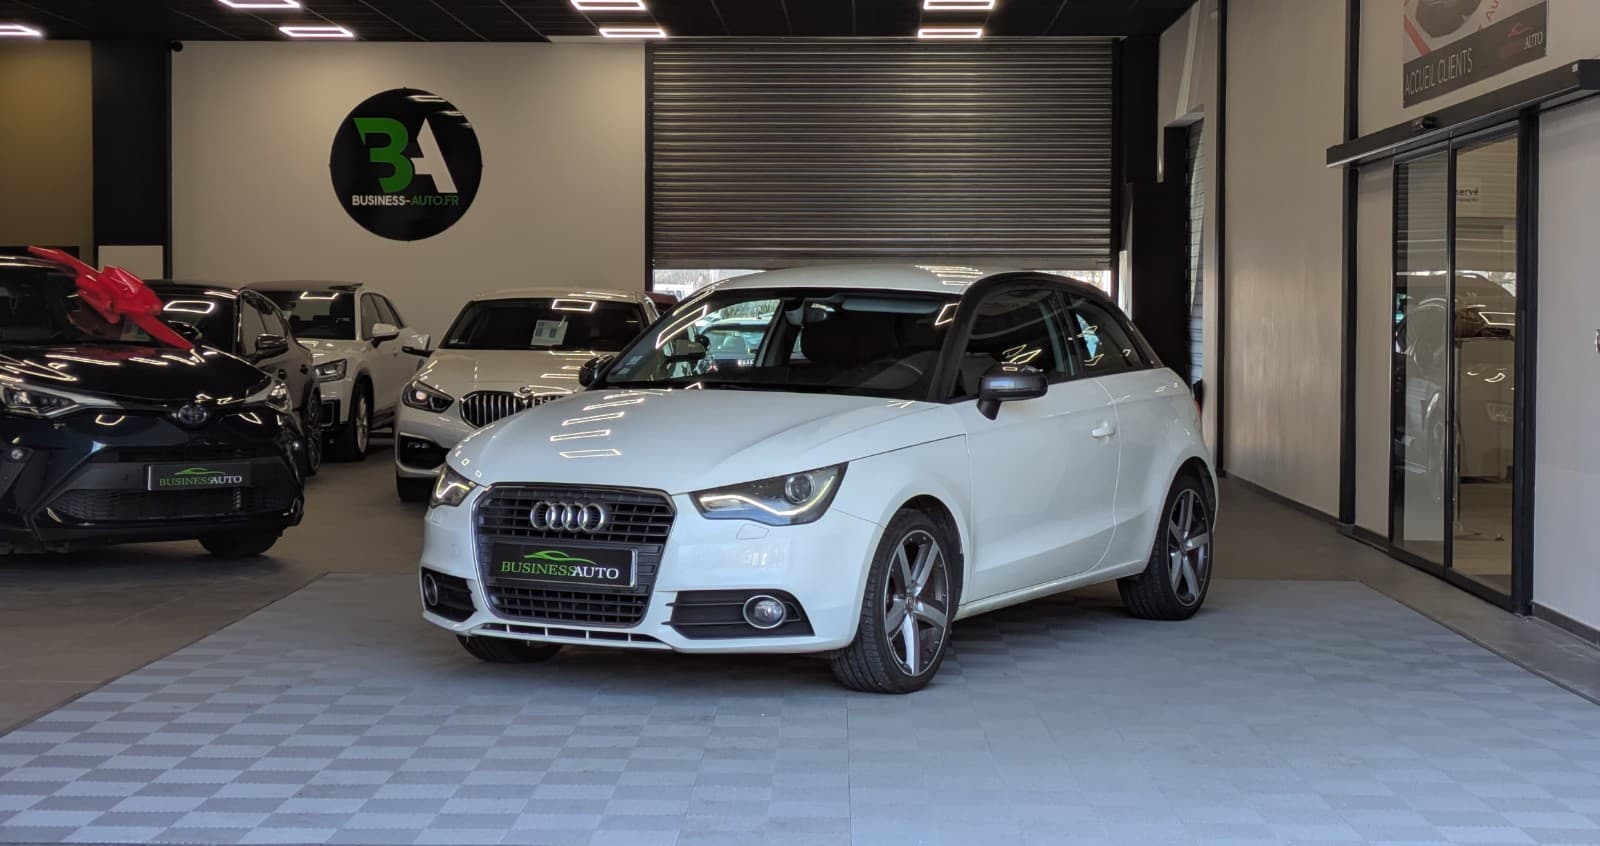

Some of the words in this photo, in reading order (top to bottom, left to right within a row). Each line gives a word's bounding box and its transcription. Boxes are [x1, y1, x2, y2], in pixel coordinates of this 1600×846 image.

[1405, 64, 1436, 97] ACCUEIL
[1438, 47, 1473, 83] CLIENTS
[353, 117, 458, 193] BA
[352, 195, 460, 206] BUSINESS-AUTO.FR
[501, 561, 619, 580] BUSINESSAUTO
